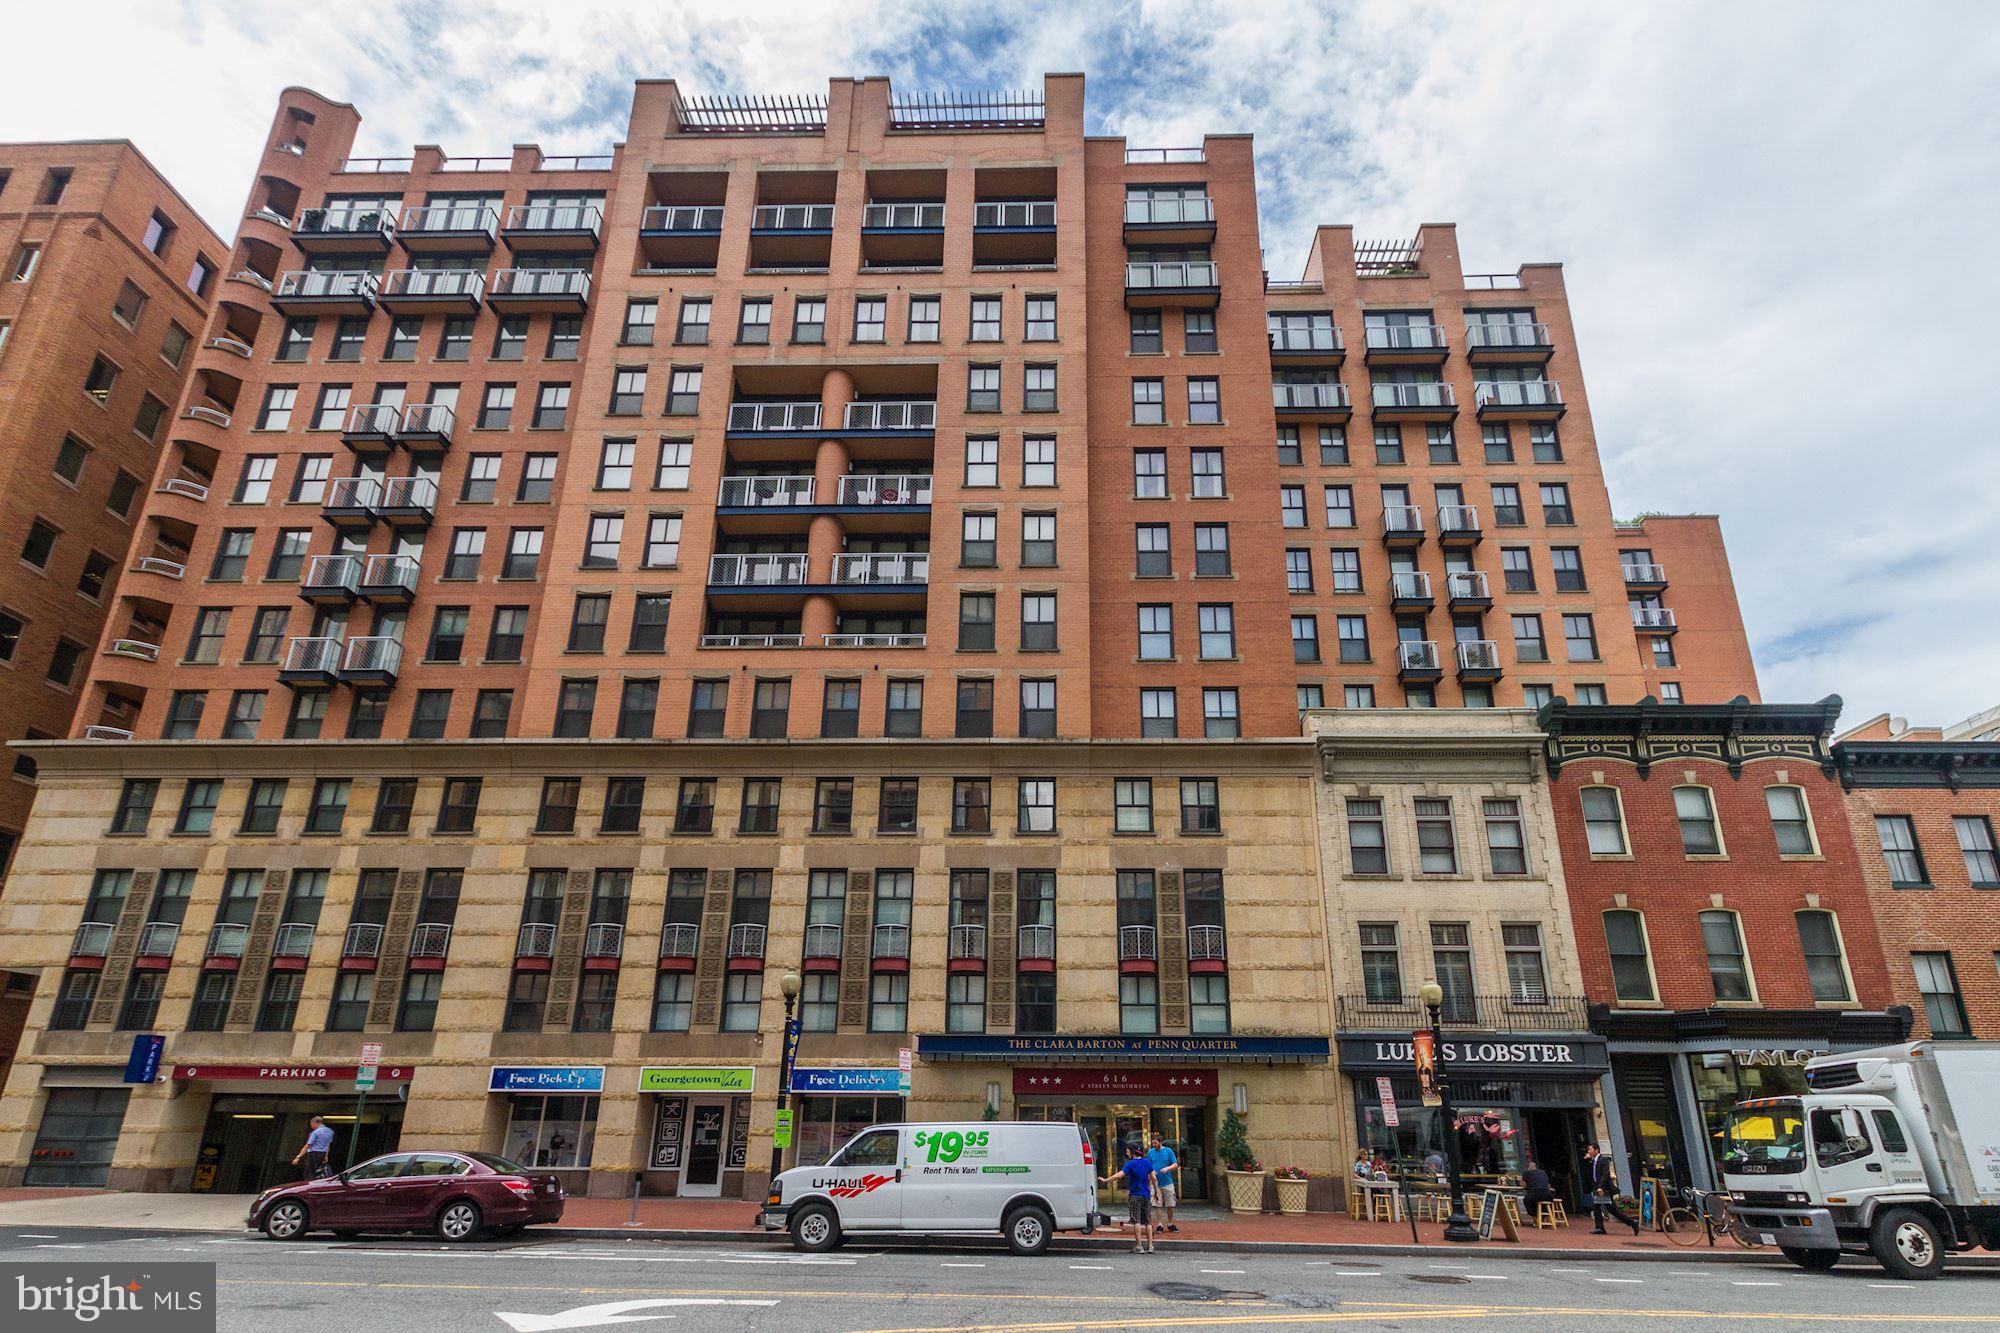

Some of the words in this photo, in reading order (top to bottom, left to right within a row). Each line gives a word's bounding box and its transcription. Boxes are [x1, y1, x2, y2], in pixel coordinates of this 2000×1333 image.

[1008, 1040, 1031, 1049] THE
[1034, 1040, 1074, 1049] CLARA
[1077, 1040, 1125, 1049] BARTON
[1148, 1040, 1179, 1049] PENN
[1182, 1040, 1238, 1050] QUARTER
[1375, 1043, 1457, 1061] LUKS
[1464, 1043, 1573, 1062] LOBSTER
[1732, 1049, 1832, 1066] TAYLO
[260, 1068, 327, 1077] PARKING
[509, 1073, 535, 1083] Free
[538, 1072, 585, 1088] Pick-Up
[650, 1073, 720, 1085] Georgetown
[809, 1074, 836, 1085] Free
[838, 1074, 887, 1085] Delivery
[1743, 1165, 1767, 1173] ISUZU
[813, 1178, 866, 1188] U-HAUL
